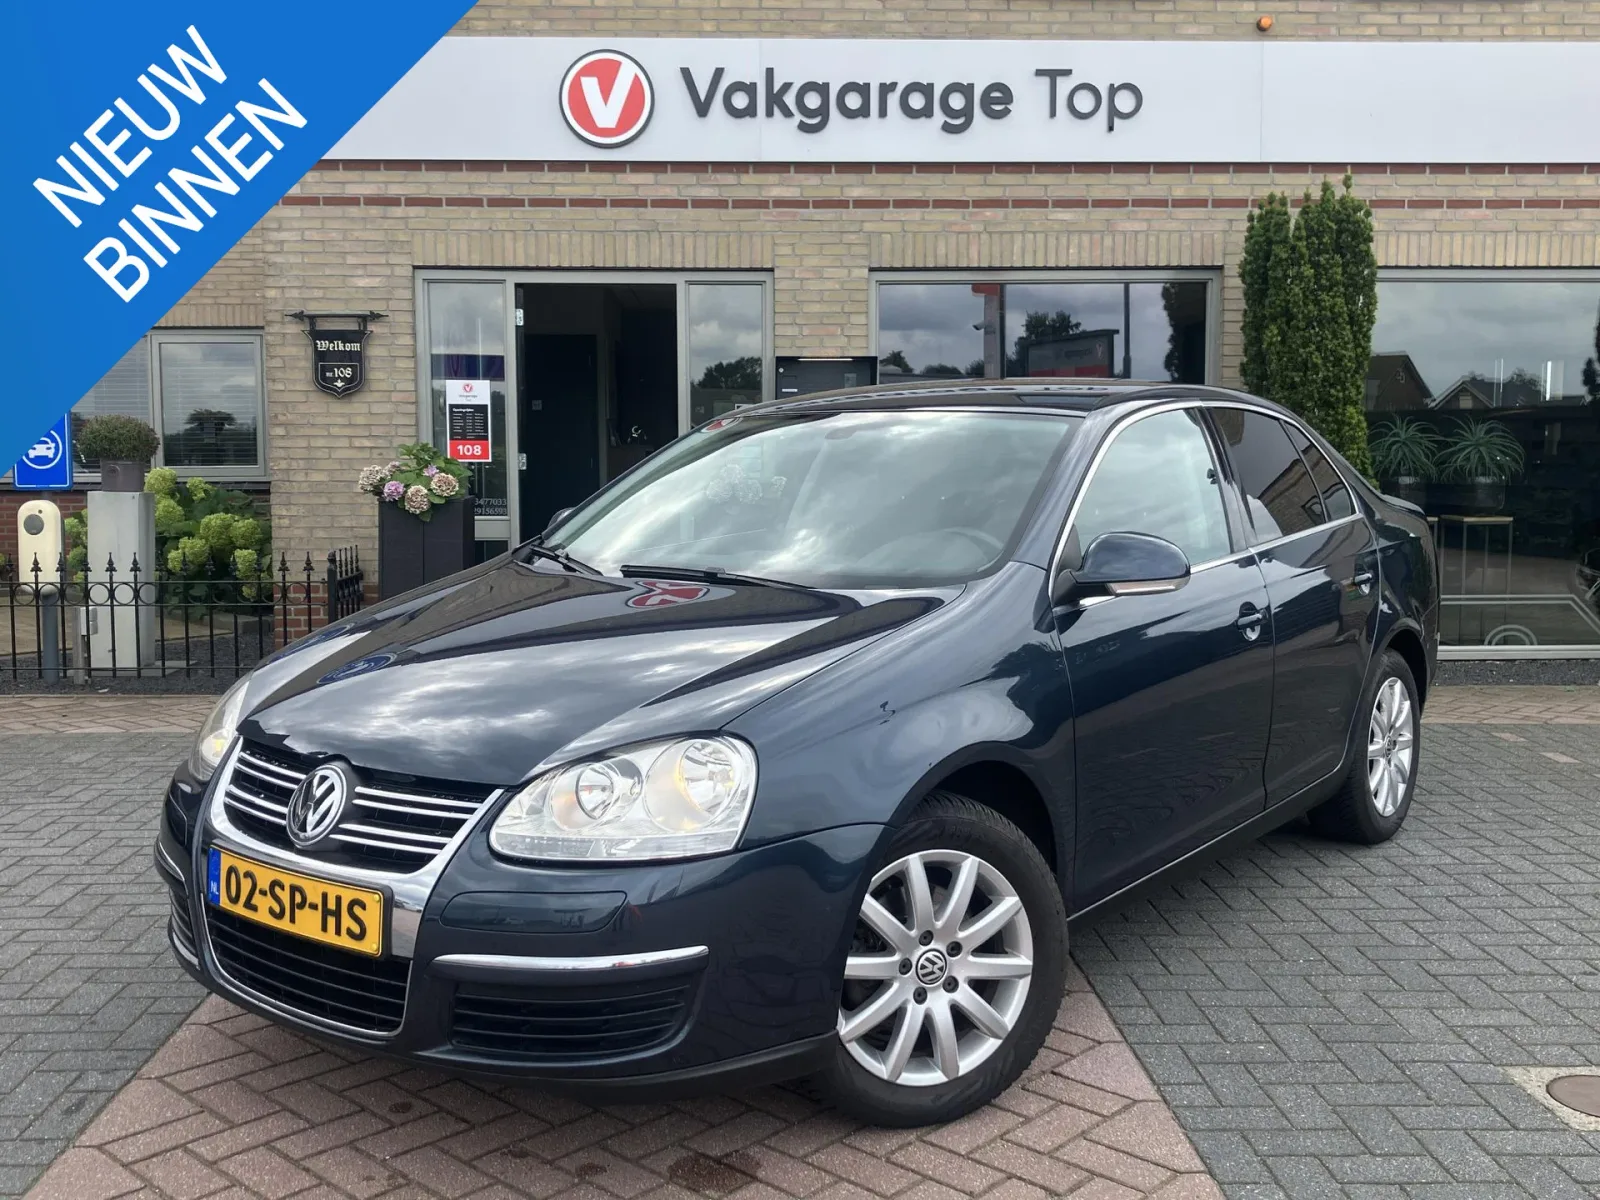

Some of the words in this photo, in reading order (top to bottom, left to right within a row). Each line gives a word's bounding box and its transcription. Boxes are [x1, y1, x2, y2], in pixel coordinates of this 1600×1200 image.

[679, 67, 1014, 134] Vakgarage
[1034, 68, 1143, 132] Top
[315, 340, 361, 351] Welkom
[334, 367, 353, 378] 108
[457, 444, 482, 456] 108
[210, 880, 219, 895] NL
[225, 864, 367, 942] 02-SP-HS
